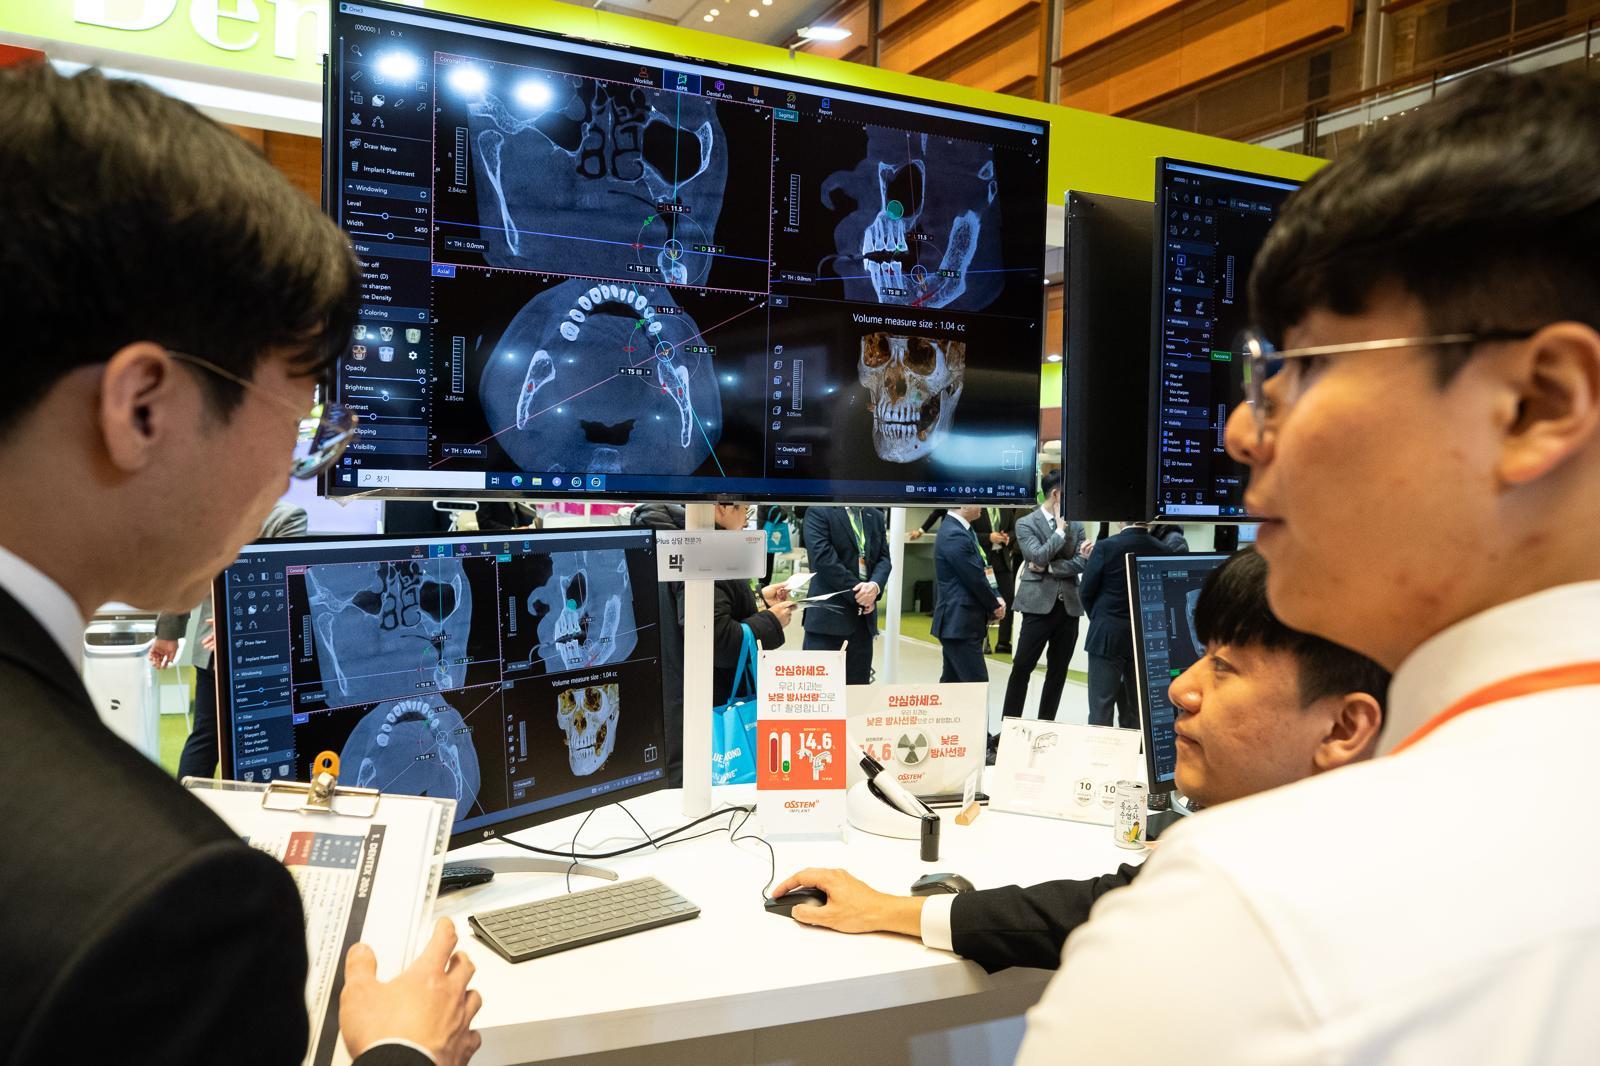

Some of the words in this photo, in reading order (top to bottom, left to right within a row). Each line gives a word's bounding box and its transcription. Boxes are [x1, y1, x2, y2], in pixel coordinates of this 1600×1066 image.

[634, 77, 653, 86] Worklist
[706, 90, 719, 98] Dental
[721, 92, 733, 100] Arch
[747, 97, 764, 105] Implant
[364, 142, 378, 150] Draw
[380, 145, 397, 153] Nerve
[363, 166, 385, 174] Implant
[386, 168, 415, 177] Placement
[355, 184, 388, 195] Windowing
[414, 226, 428, 234] 5450
[369, 283, 391, 291] sharpen
[371, 294, 392, 302] Density
[364, 309, 388, 317] Coloring
[852, 313, 882, 324] Volume
[884, 317, 916, 328] measure
[919, 319, 933, 329] size
[940, 321, 955, 331] 1.04
[345, 364, 367, 373] Opacity
[669, 554, 684, 573] 박
[775, 665, 829, 676] 안심하세요.
[552, 679, 570, 687] Volume
[571, 676, 590, 684] measure
[778, 682, 795, 691] 우리
[798, 682, 823, 691] 치과는
[768, 693, 784, 702] 낮은
[786, 692, 836, 702] 방사선량으로
[888, 694, 942, 707] 안심하세요.
[771, 704, 781, 713] CT
[785, 704, 832, 713] 촬영합니다.
[867, 717, 883, 726] 낮은
[799, 732, 833, 750] 14.6
[941, 735, 959, 746] 낮은
[930, 747, 966, 758] 방사선량
[1079, 782, 1091, 791] 10
[1104, 785, 1115, 794] 10
[784, 800, 816, 809] OSSTEM
